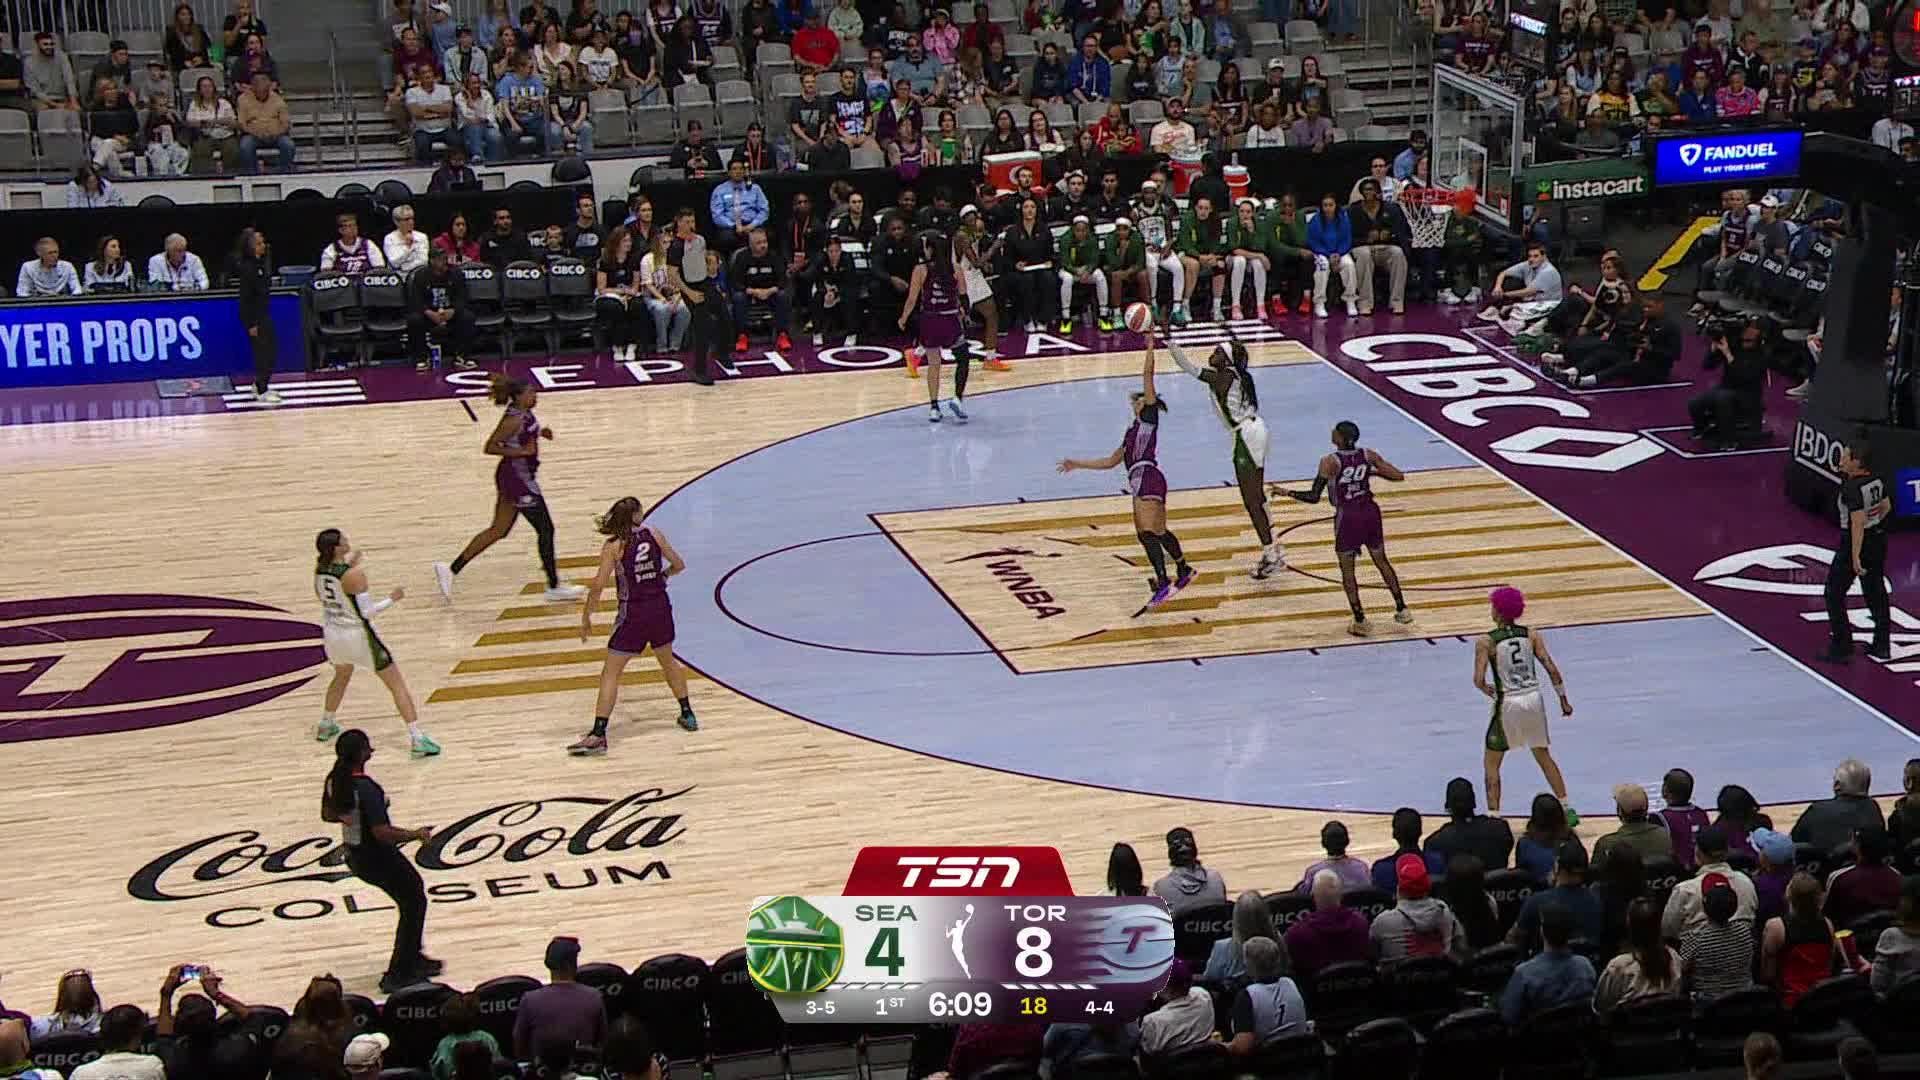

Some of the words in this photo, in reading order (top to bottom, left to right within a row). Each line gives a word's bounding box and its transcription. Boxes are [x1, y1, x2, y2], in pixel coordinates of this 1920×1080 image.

[1704, 143, 1778, 161] FANDUEL
[1553, 176, 1644, 199] instacart
[0, 322, 72, 368] YER
[80, 316, 202, 364] PROPS
[1339, 464, 1367, 483] 20
[635, 541, 650, 561] 2
[323, 579, 336, 600] 5
[985, 559, 1066, 619] WNBA
[1508, 641, 1523, 665] 2
[205, 861, 671, 928] COLSEUM
